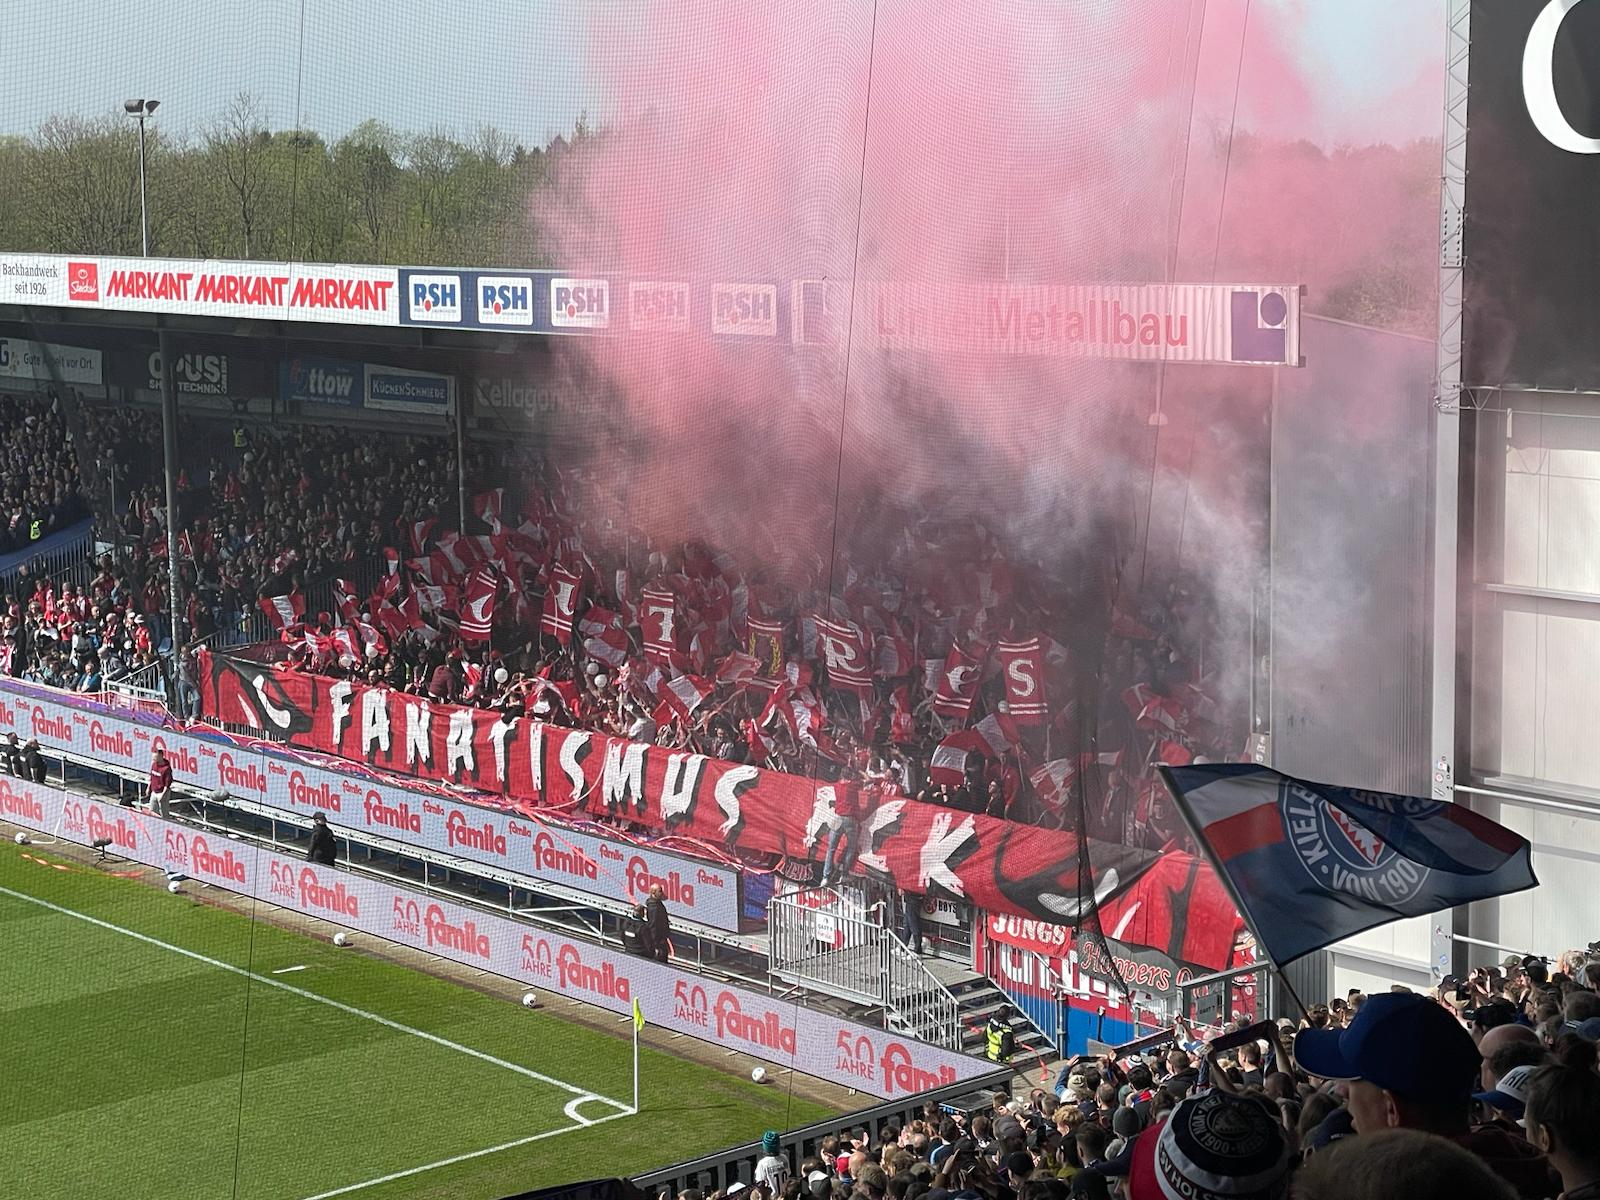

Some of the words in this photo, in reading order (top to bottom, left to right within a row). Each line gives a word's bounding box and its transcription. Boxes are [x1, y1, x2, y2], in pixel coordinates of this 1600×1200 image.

[3, 263, 58, 278] Backhandwerk
[107, 271, 192, 301] MARKANT
[15, 282, 28, 294] seit
[30, 282, 47, 296] 1926
[195, 274, 288, 305] MARKANT
[290, 278, 393, 311] MARKANT
[413, 283, 456, 307] RSH
[482, 285, 528, 310] RSH
[555, 286, 604, 313] RSH
[987, 296, 1188, 348] Metallbau
[1008, 658, 1036, 697] S
[31, 706, 72, 741] famila
[89, 719, 133, 757] famila
[217, 752, 267, 793] famila
[330, 680, 760, 837] FANATISMUS
[287, 770, 341, 813] famila
[363, 788, 422, 834] famila
[423, 800, 445, 816] famila
[87, 805, 137, 850] famila
[165, 829, 188, 852] 50
[446, 808, 508, 857] famila
[508, 820, 531, 838] famila
[190, 835, 246, 883] famila
[533, 830, 598, 881] famila
[600, 843, 624, 862] famila
[270, 859, 295, 886] 50
[696, 868, 724, 888] famila
[1332, 863, 1383, 902] VON
[269, 879, 295, 900] JAHRE
[297, 867, 359, 919] famila
[393, 895, 421, 925] 50
[392, 919, 421, 938] JAHRE
[423, 903, 490, 959] famila
[992, 912, 1067, 946] JUNGS
[521, 933, 552, 964] 50
[520, 956, 552, 979] JAHRE
[556, 943, 630, 1004] famila
[674, 979, 708, 1012] 50
[673, 1005, 708, 1028] JAHRE
[712, 991, 797, 1056] famila
[836, 1029, 875, 1064] 50
[835, 1055, 875, 1081] JAHRE
[1200, 1132, 1231, 1154] 1900
